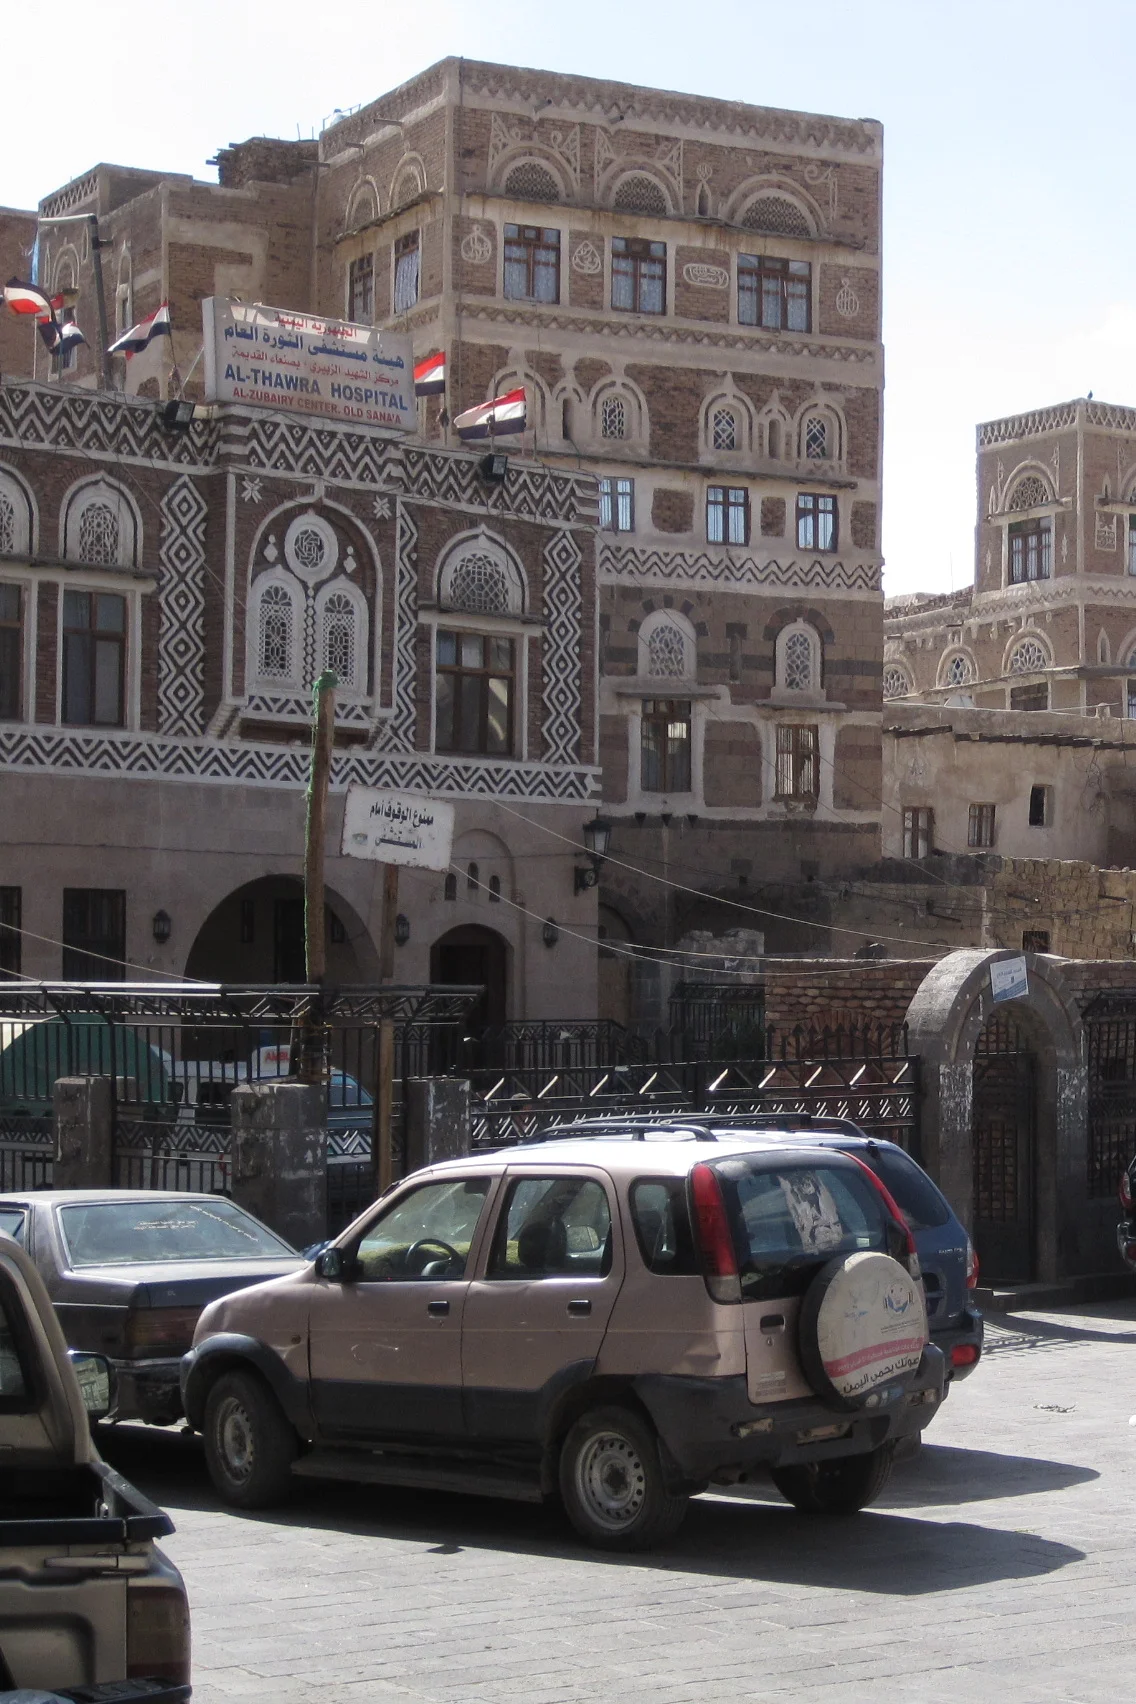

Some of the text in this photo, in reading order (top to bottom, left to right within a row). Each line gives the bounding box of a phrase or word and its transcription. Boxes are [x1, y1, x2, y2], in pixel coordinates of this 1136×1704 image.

[224, 323, 259, 342] العام
[262, 331, 304, 350] الثورة
[231, 345, 268, 361] القديمة
[308, 341, 368, 362] مستشفى
[309, 361, 341, 377] الزبيري
[344, 366, 371, 380] الشهيد
[224, 363, 409, 411] AL-THAWRA HOSPITAL
[376, 372, 399, 386] مركز
[233, 387, 295, 407] AL-ZUBAIRY
[344, 405, 364, 419] OLD
[366, 410, 402, 425] SANA'A
[384, 801, 412, 824] الوقوف
[412, 808, 434, 828] ممنوع
[843, 1373, 869, 1394] اليمن
